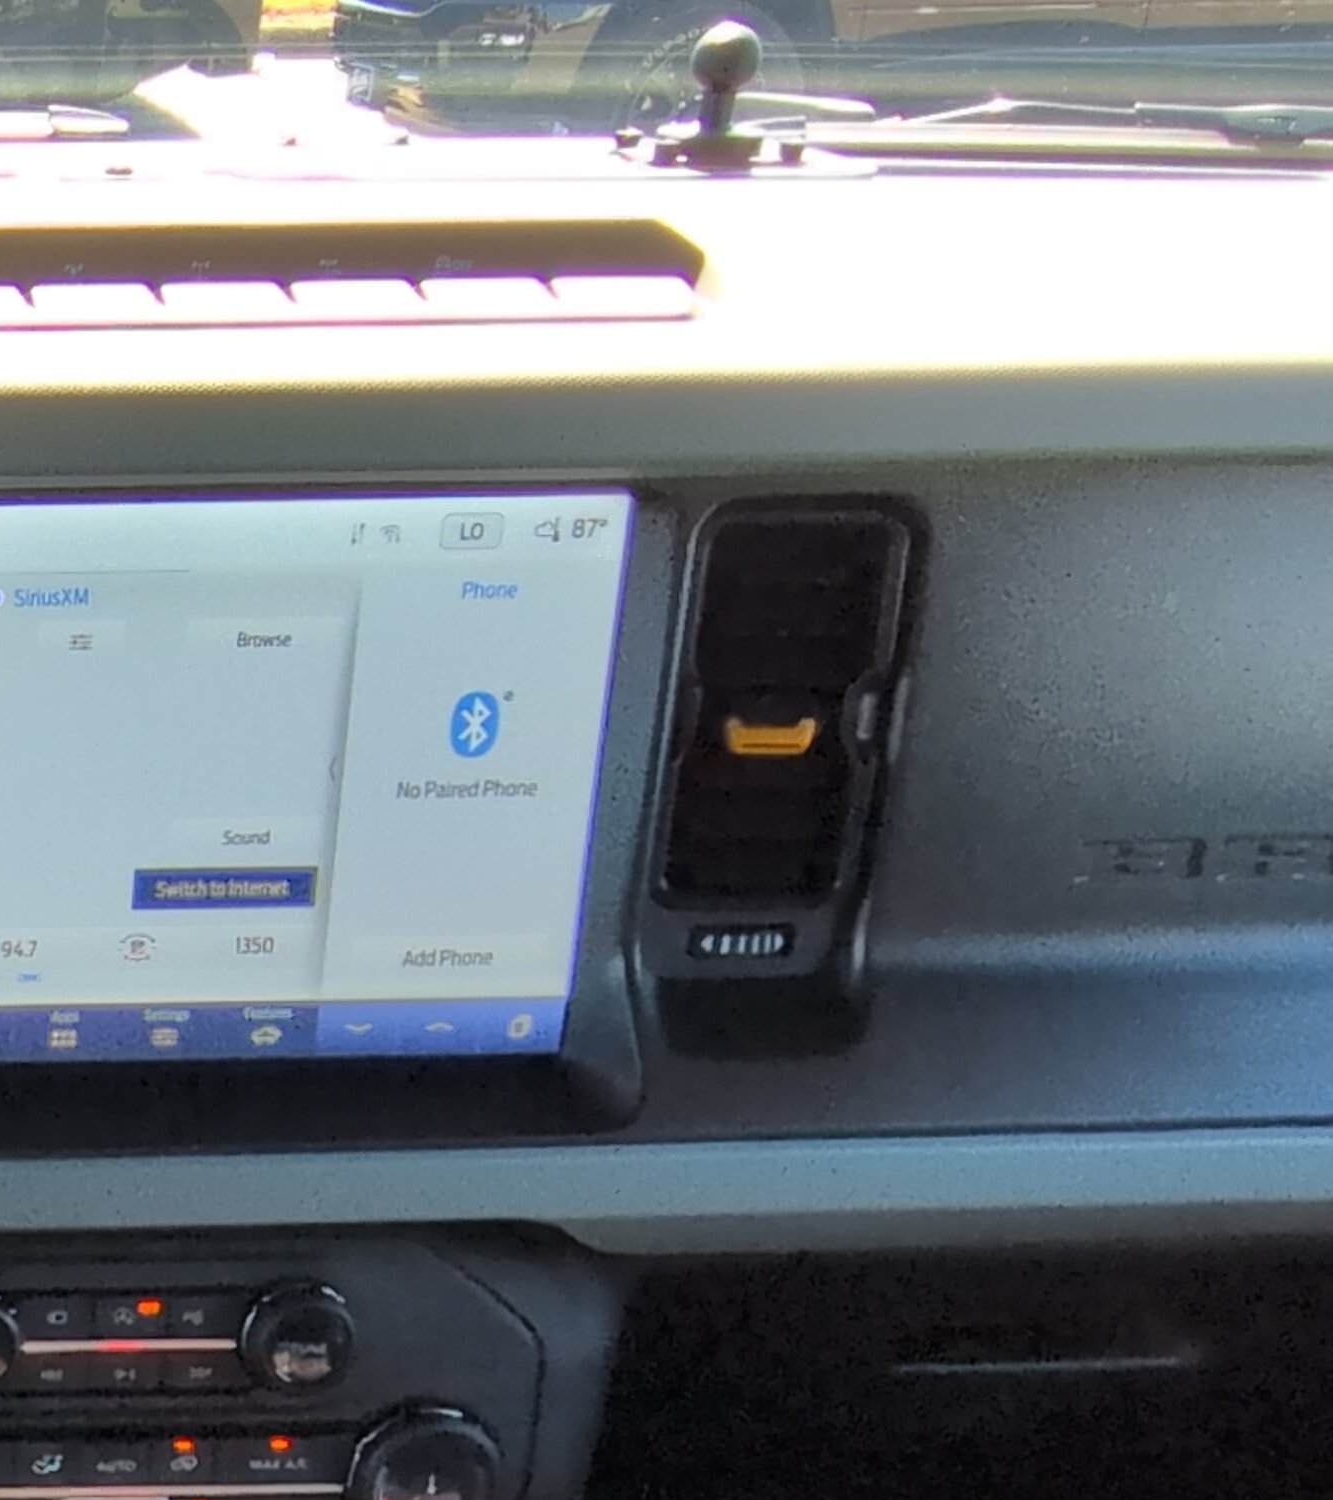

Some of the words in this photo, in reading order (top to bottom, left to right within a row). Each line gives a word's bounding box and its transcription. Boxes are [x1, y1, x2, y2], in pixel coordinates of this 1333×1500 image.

[459, 522, 484, 541] LO
[13, 587, 89, 608] SiriusXM
[461, 581, 518, 600] Phone
[236, 631, 293, 648] Browse
[396, 782, 420, 798] No
[424, 780, 479, 798] Paired
[482, 779, 538, 797] Phone
[221, 830, 271, 846] Sound
[154, 879, 207, 898] Switch
[209, 879, 226, 897] to
[1, 940, 38, 958] 94.7
[235, 936, 274, 954] 1350
[402, 951, 436, 966] Add
[439, 949, 493, 966] Phone
